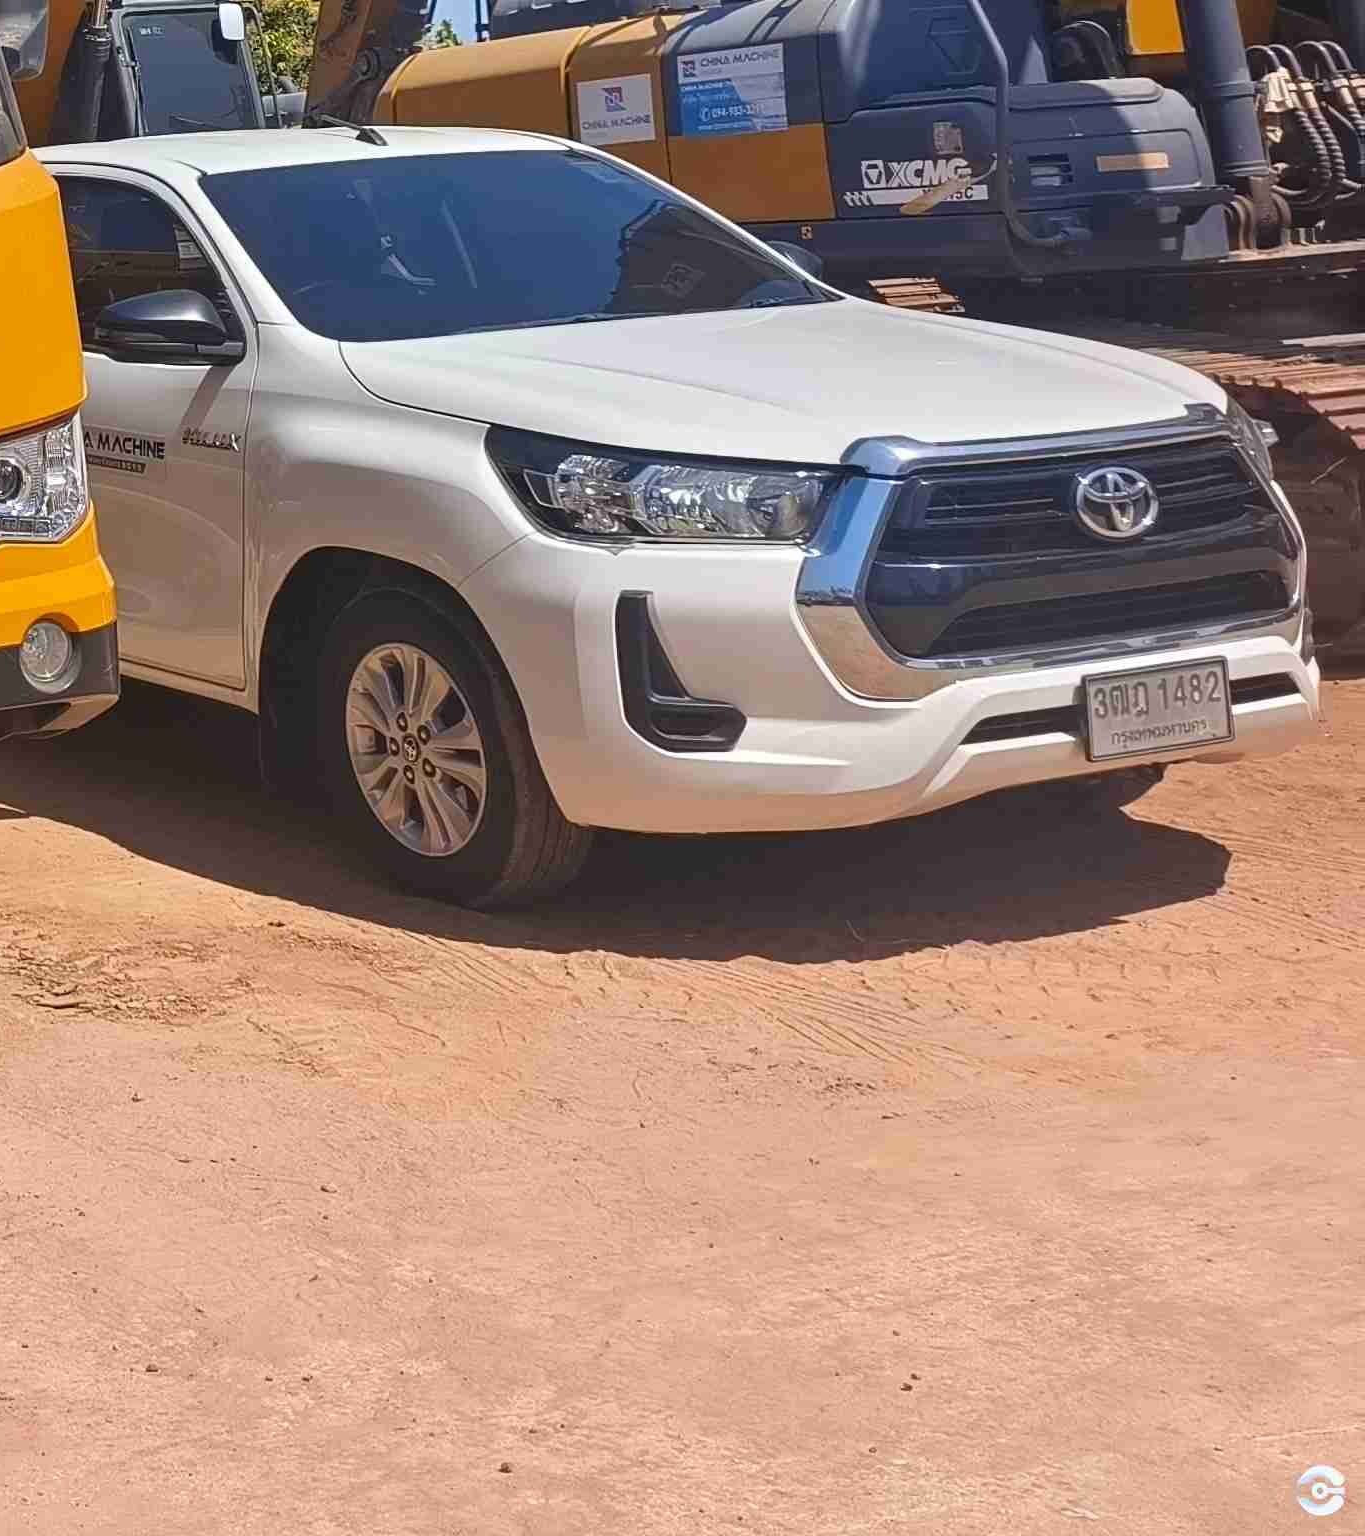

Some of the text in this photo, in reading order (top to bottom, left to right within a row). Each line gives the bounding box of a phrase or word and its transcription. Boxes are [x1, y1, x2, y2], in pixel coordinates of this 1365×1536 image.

[701, 55, 729, 68] CHINA
[886, 157, 972, 188] XCMG
[96, 433, 166, 460] MACHINE
[1156, 670, 1222, 711] 1482
